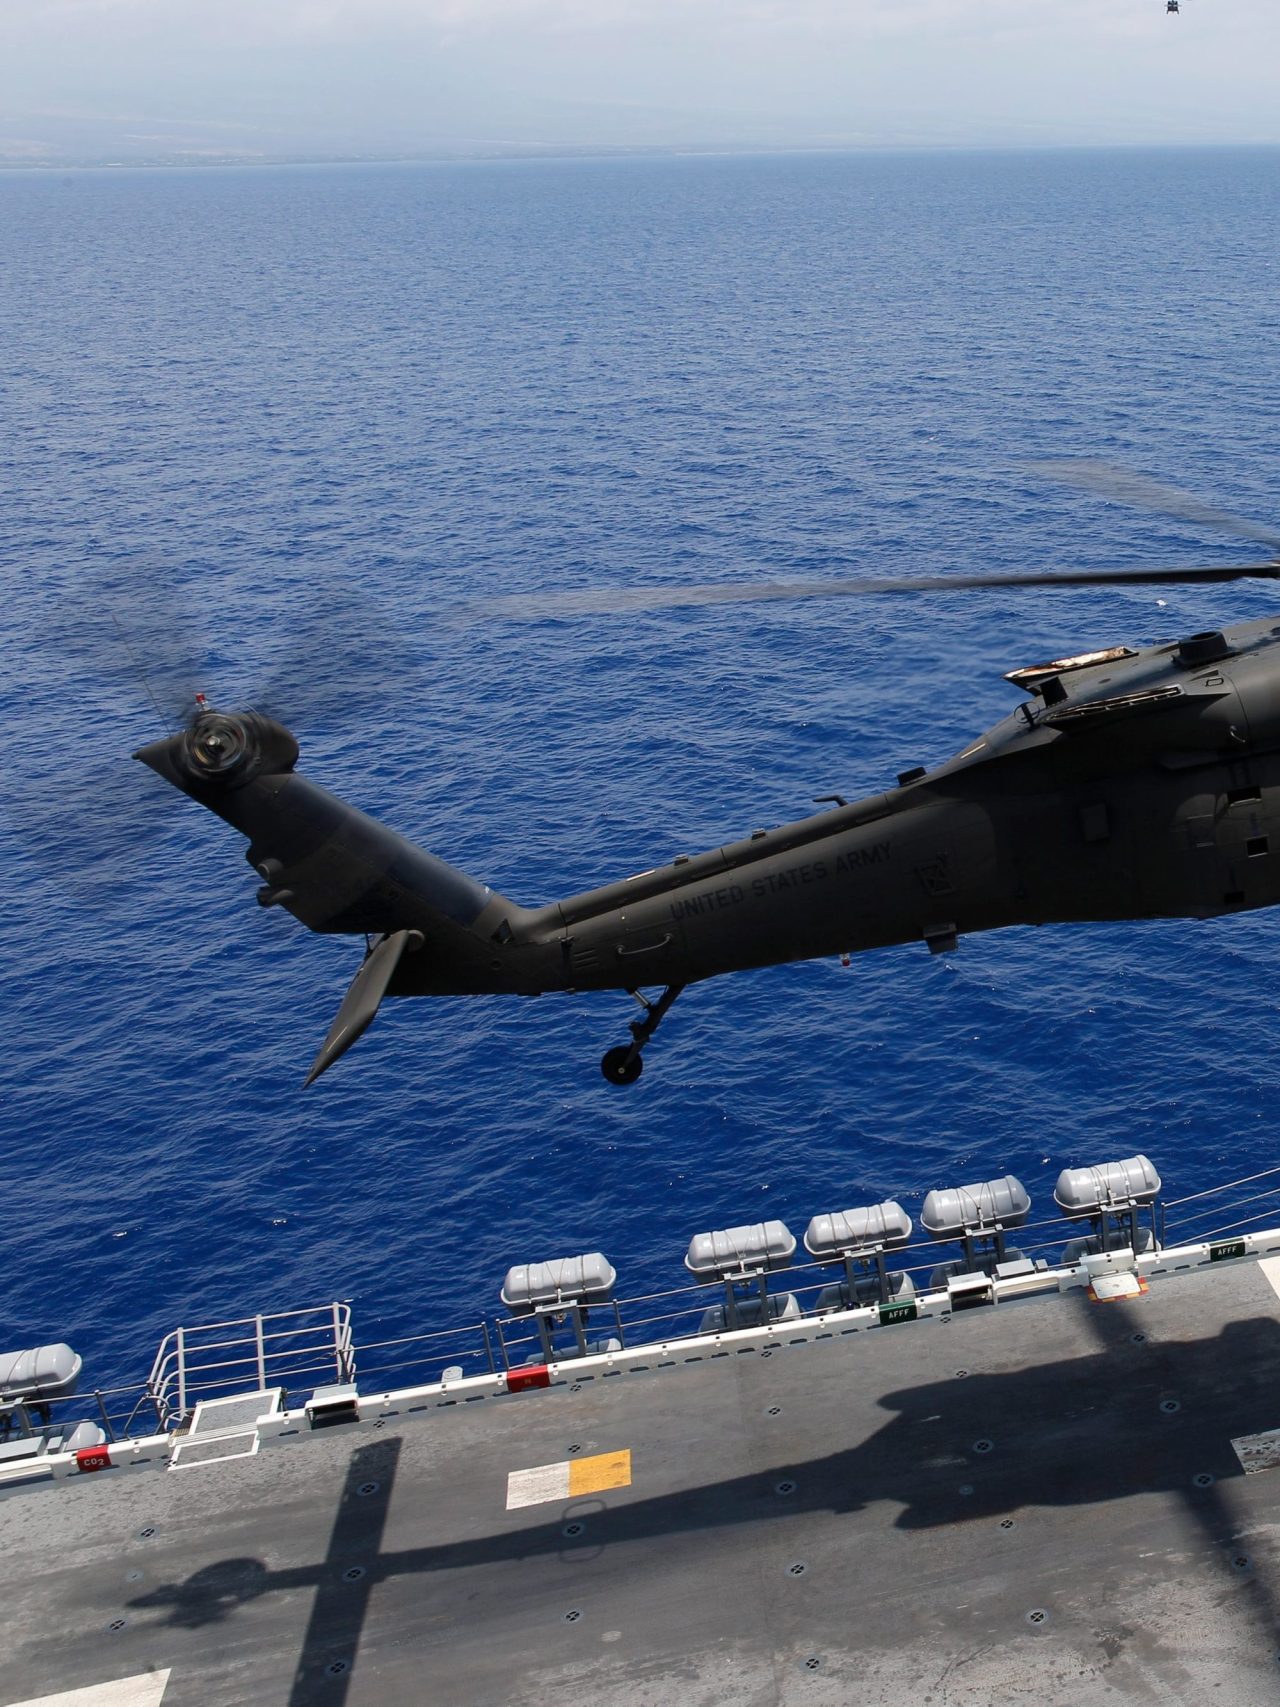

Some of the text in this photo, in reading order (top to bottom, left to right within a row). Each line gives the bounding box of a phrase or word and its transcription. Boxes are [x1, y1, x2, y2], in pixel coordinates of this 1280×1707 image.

[670, 842, 891, 920] UNITED STATES ARMY
[1217, 1246, 1238, 1256] AFFF
[888, 1308, 910, 1319] AFFF
[83, 1457, 105, 1466] CO2
